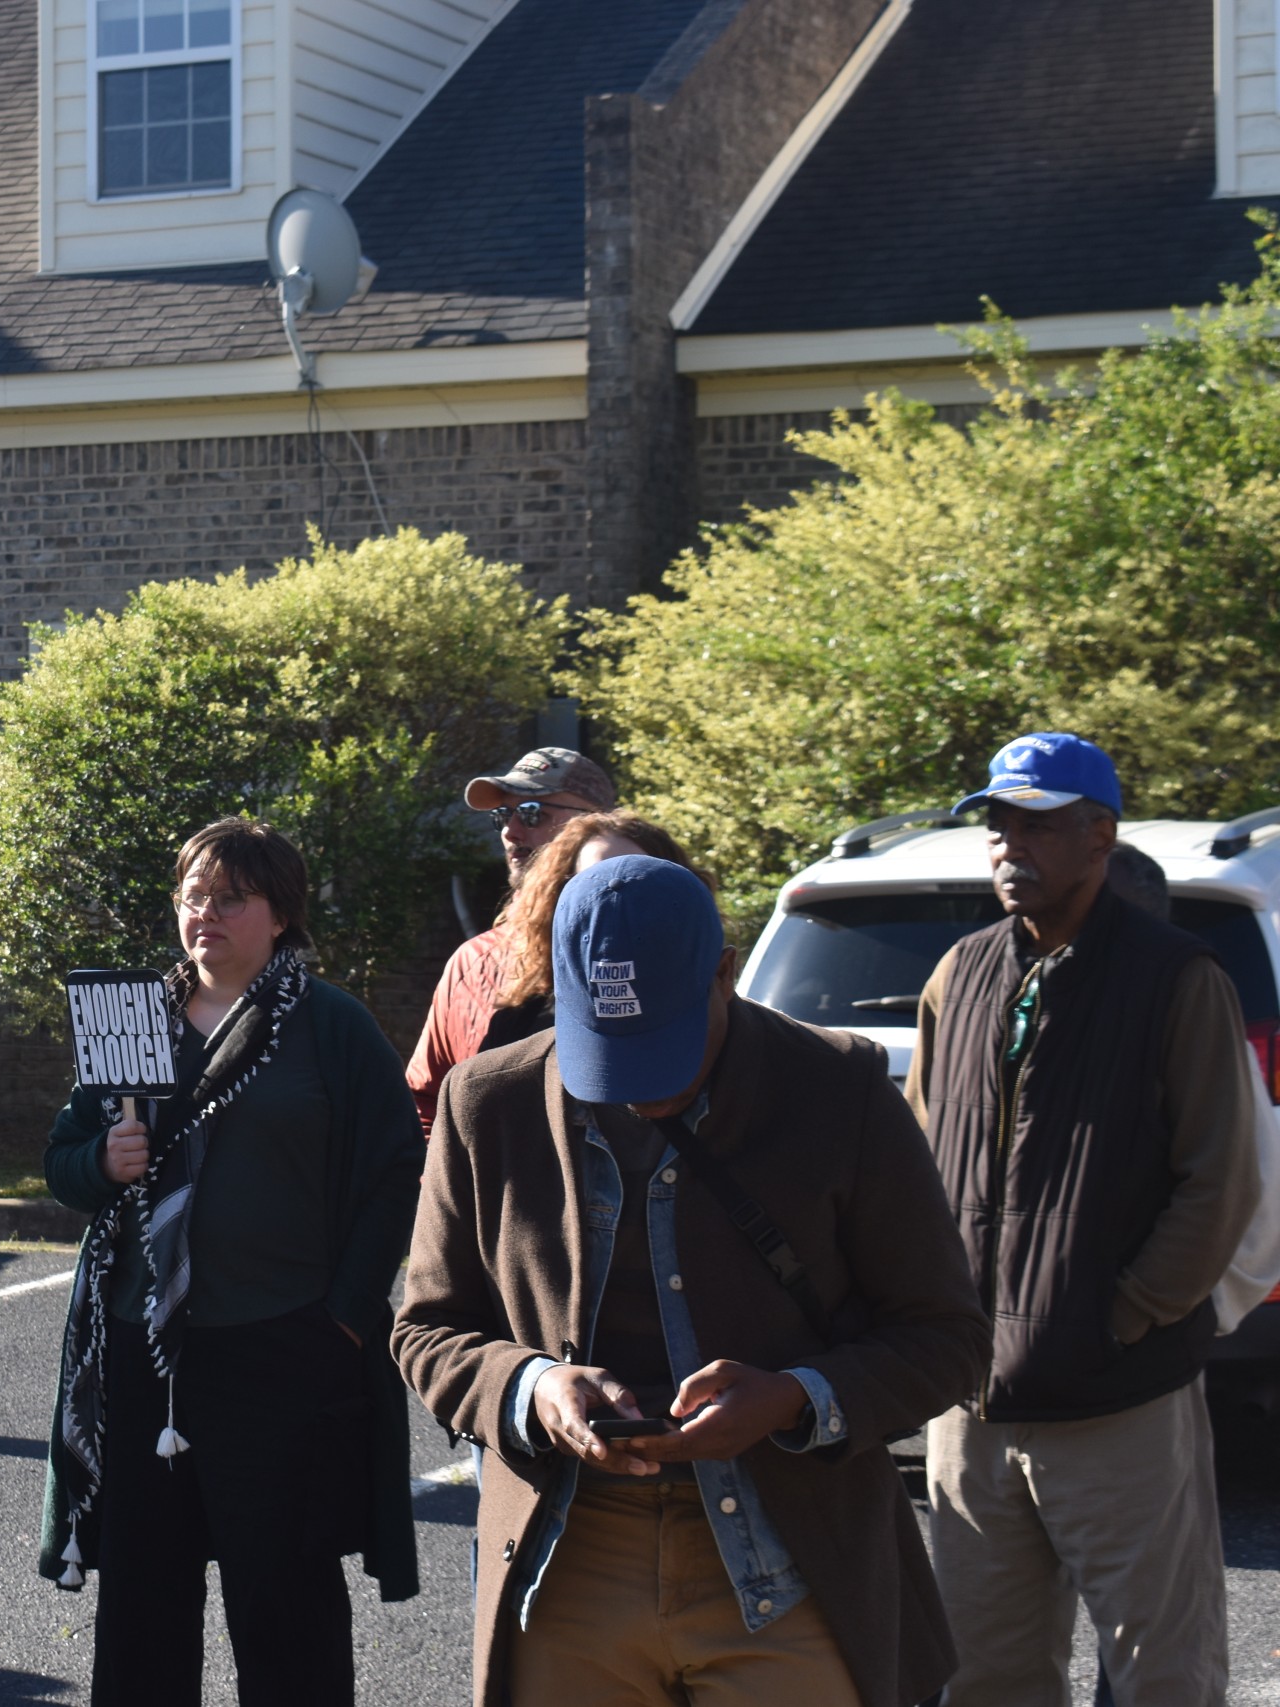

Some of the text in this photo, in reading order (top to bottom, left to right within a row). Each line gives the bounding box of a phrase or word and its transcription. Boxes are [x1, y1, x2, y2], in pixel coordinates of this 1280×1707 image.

[594, 964, 631, 980] KNOW
[600, 984, 628, 998] YOUR
[67, 981, 168, 1036] ENOUGH IS
[598, 1001, 635, 1015] RIGHTS
[75, 1034, 175, 1086] ENOUGH
